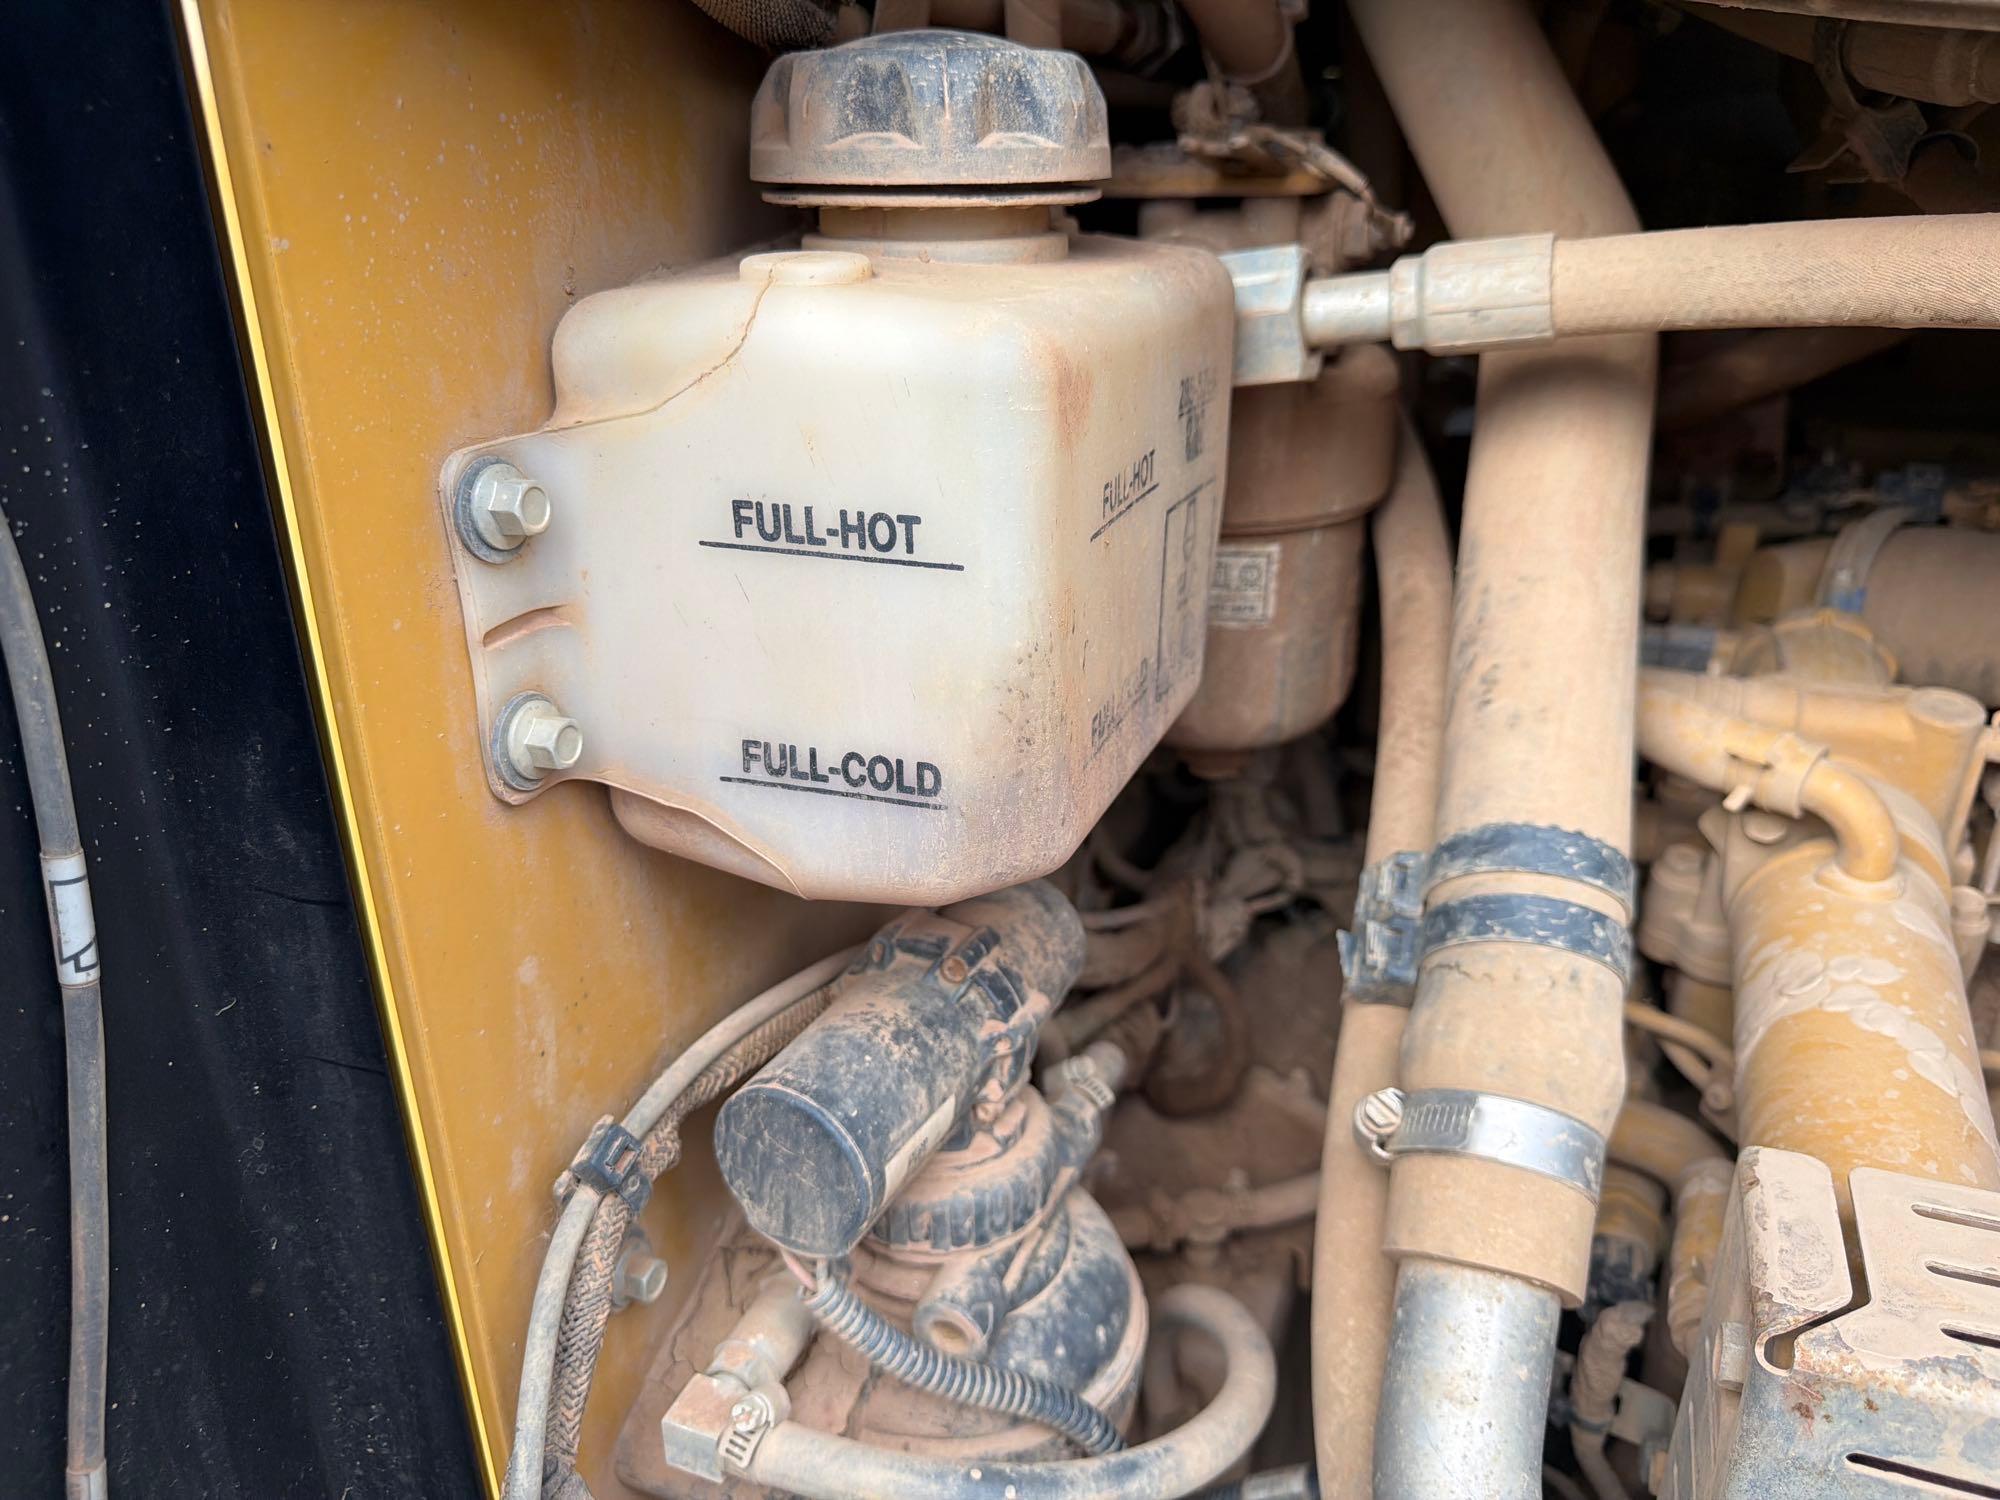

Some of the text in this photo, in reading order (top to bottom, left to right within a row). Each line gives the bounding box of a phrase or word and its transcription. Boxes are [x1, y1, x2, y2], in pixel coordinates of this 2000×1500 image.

[1103, 449, 1156, 519] FULL-HOT
[732, 499, 922, 554] FULL-HOT
[742, 739, 942, 798] FULL-COLD
